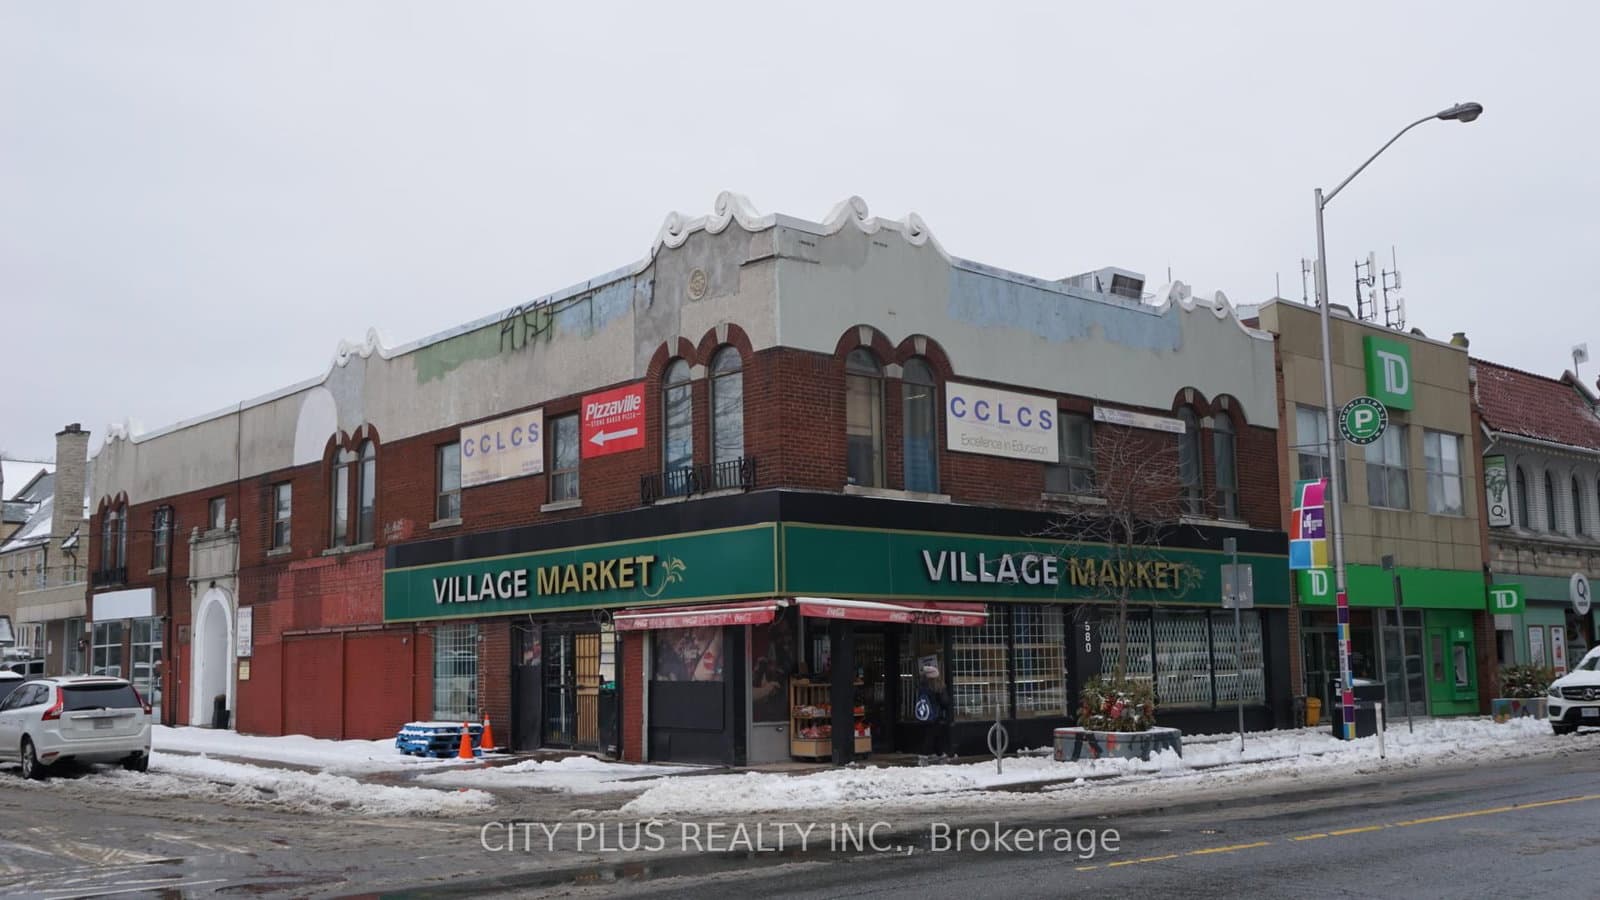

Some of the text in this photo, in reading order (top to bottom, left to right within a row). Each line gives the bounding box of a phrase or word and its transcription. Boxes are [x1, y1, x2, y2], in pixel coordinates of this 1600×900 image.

[1376, 350, 1409, 395] TD
[585, 395, 641, 421] Pizzaville
[950, 396, 1053, 431] CCLCS
[1355, 410, 1373, 429] P
[463, 422, 539, 458] CCLCS
[432, 555, 655, 605] VILLAGE MARKET
[922, 550, 1186, 591] VILLAGE MARKET
[1307, 570, 1328, 596] TD
[1490, 589, 1518, 609] TD
